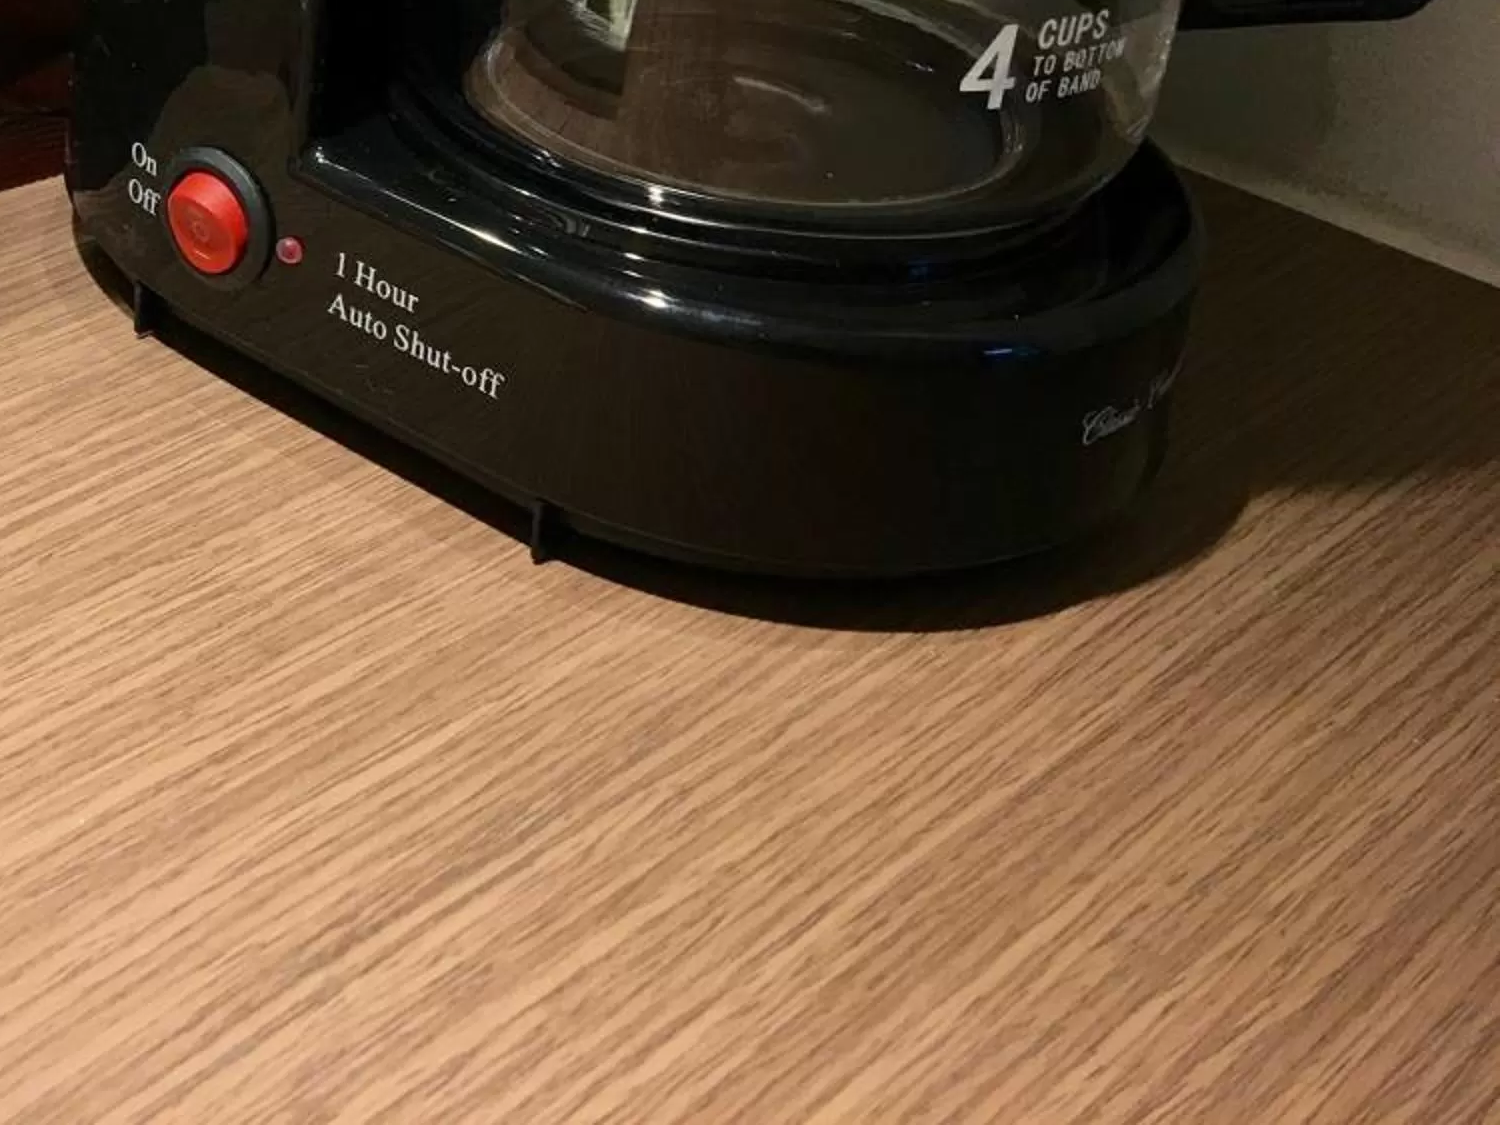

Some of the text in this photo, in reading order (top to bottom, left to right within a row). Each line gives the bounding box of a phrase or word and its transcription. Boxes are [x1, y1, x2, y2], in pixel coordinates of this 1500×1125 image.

[959, 8, 1111, 110] 4 CUPS
[1033, 54, 1057, 77] TO
[1025, 69, 1103, 104] OF BAND
[130, 141, 159, 177] On
[127, 178, 162, 218] Off
[334, 251, 420, 315] 1 Hour
[326, 293, 506, 401] Auto Shut-off
